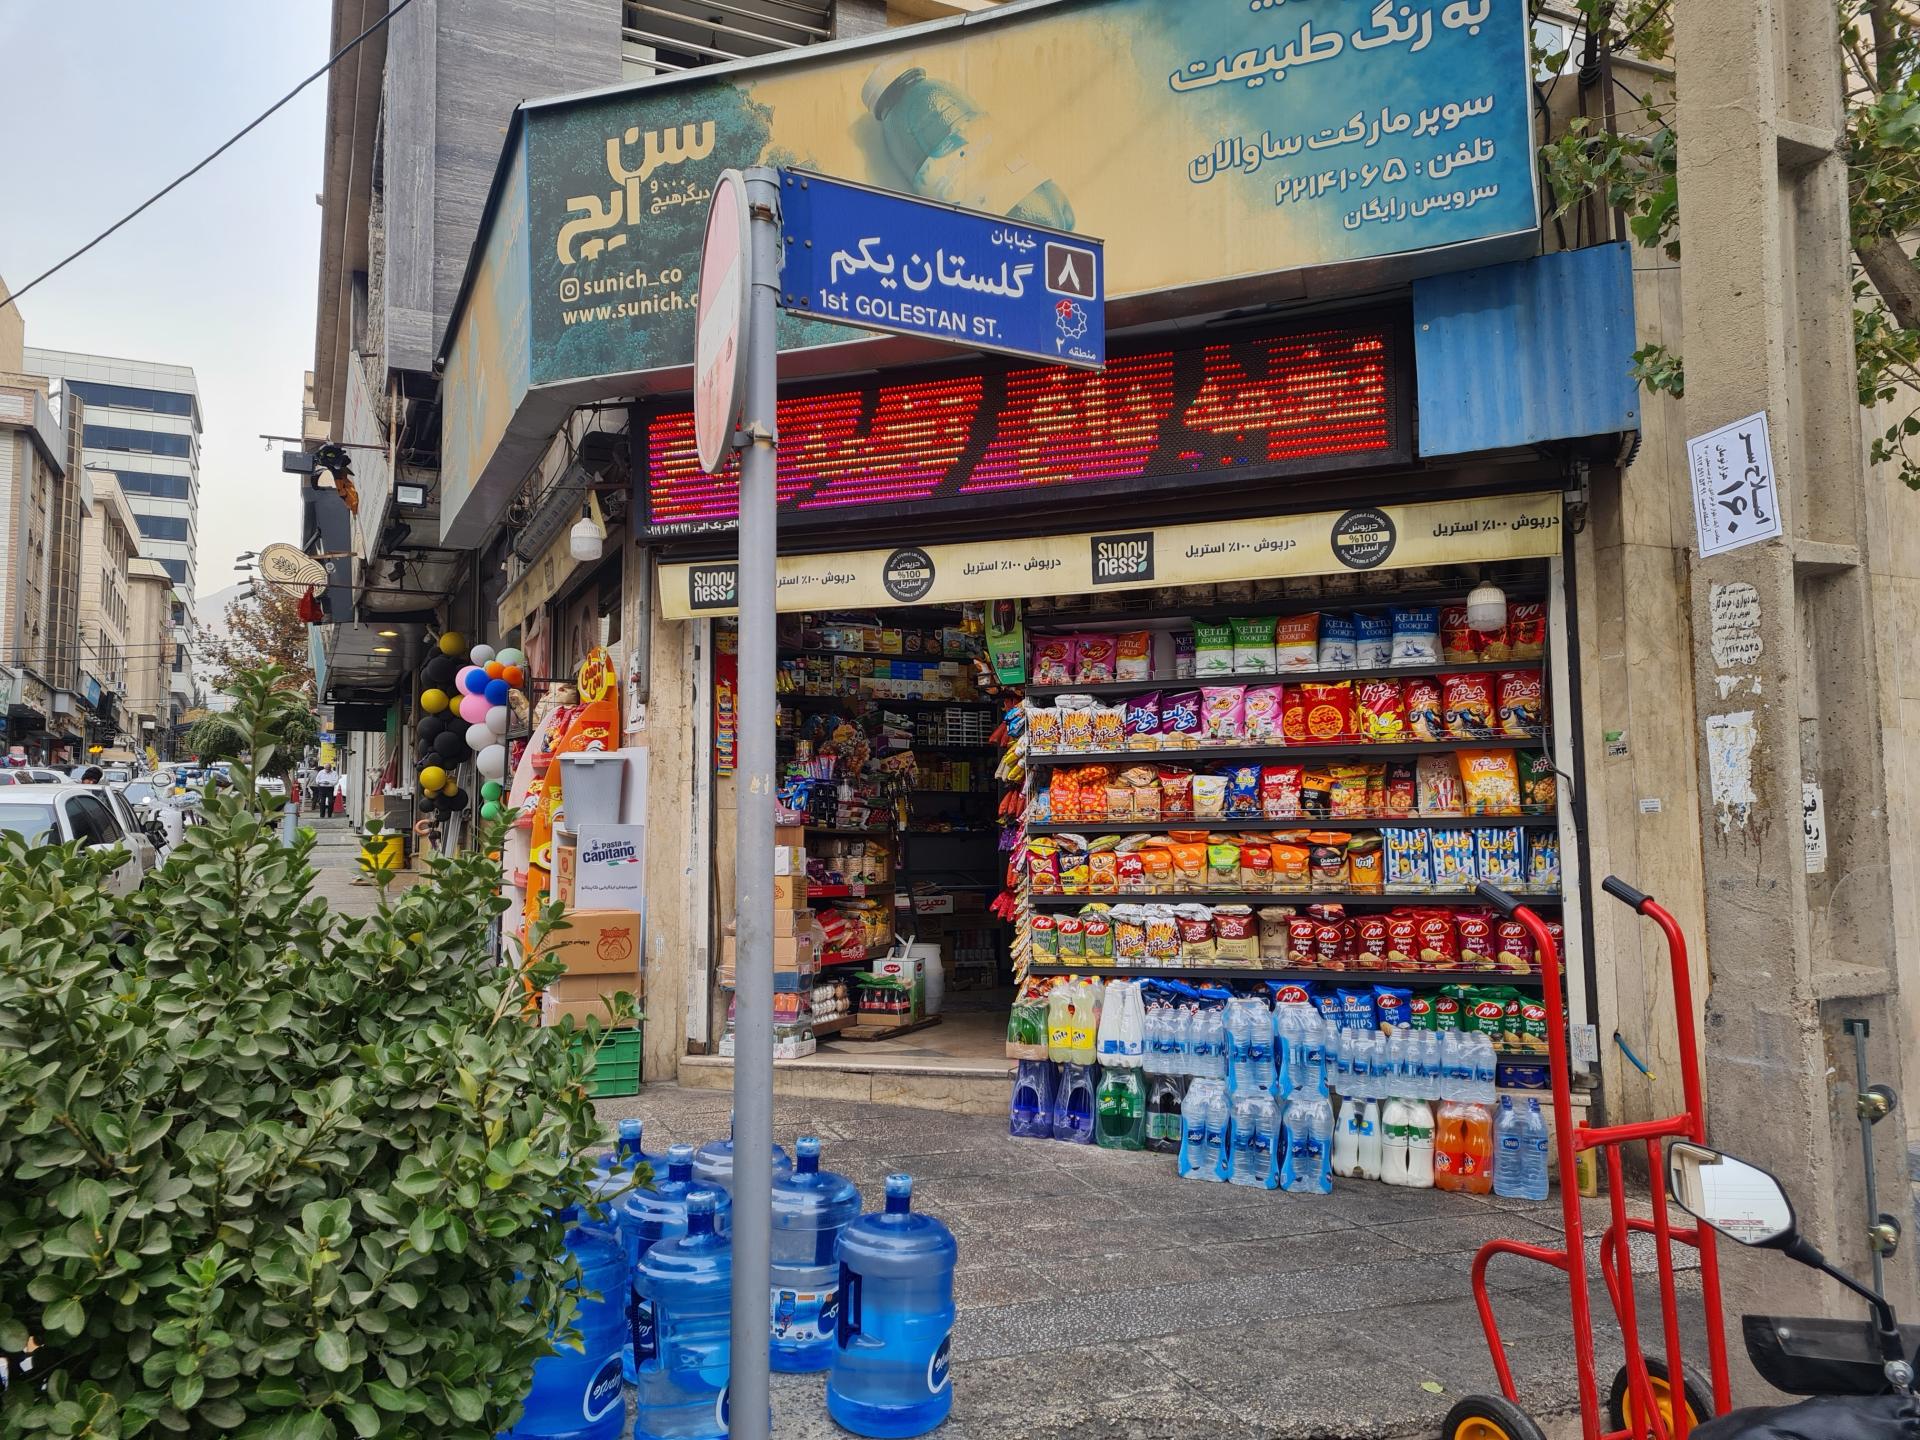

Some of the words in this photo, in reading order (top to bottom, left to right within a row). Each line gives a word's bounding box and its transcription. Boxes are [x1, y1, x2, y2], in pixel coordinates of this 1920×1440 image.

[1352, 0, 1432, 52] رنگ
[1412, 94, 1494, 137] سوپر
[1307, 108, 1413, 148] مارکت
[1188, 131, 1302, 182] ساوالان
[1411, 182, 1498, 216] سرویس
[1343, 199, 1406, 230] رایگان
[991, 227, 1037, 253] خیابان
[829, 237, 897, 290] یکم
[1057, 252, 1080, 292] ۸
[583, 268, 682, 295] sunich_co
[903, 248, 1035, 298] گلستان
[562, 291, 700, 325] www.sunich.c
[819, 288, 849, 312] 1st
[855, 295, 967, 333] GOLESTAN
[972, 316, 1003, 338] ST.
[1068, 346, 1096, 360] منطقه
[1739, 432, 1757, 463] سر
[1745, 465, 1772, 525] اصلاح
[1717, 480, 1747, 534] ۱۶۰
[1349, 523, 1378, 532] درپوش
[1432, 519, 1479, 538] استریل
[1516, 514, 1560, 532] درپوش
[1254, 538, 1296, 555] درپوش
[1349, 533, 1378, 543] %100
[1184, 541, 1225, 559] استریل
[1349, 543, 1379, 555] استریل
[897, 560, 920, 569] درپوش
[963, 560, 998, 576] استریل
[1023, 558, 1061, 573] درپوش
[777, 576, 800, 588] استر
[821, 573, 856, 586] درپوش
[898, 570, 921, 578] %100
[897, 579, 921, 589] استریل
[1395, 613, 1432, 622] KETTLE
[1198, 627, 1231, 637] KETTLE
[1236, 625, 1271, 634] KETTLE
[1277, 623, 1310, 633] KETTLE
[1305, 776, 1324, 785] pop
[602, 840, 622, 849] Pasta
[583, 846, 635, 863] Capitano
[1321, 1004, 1341, 1013] Delin
